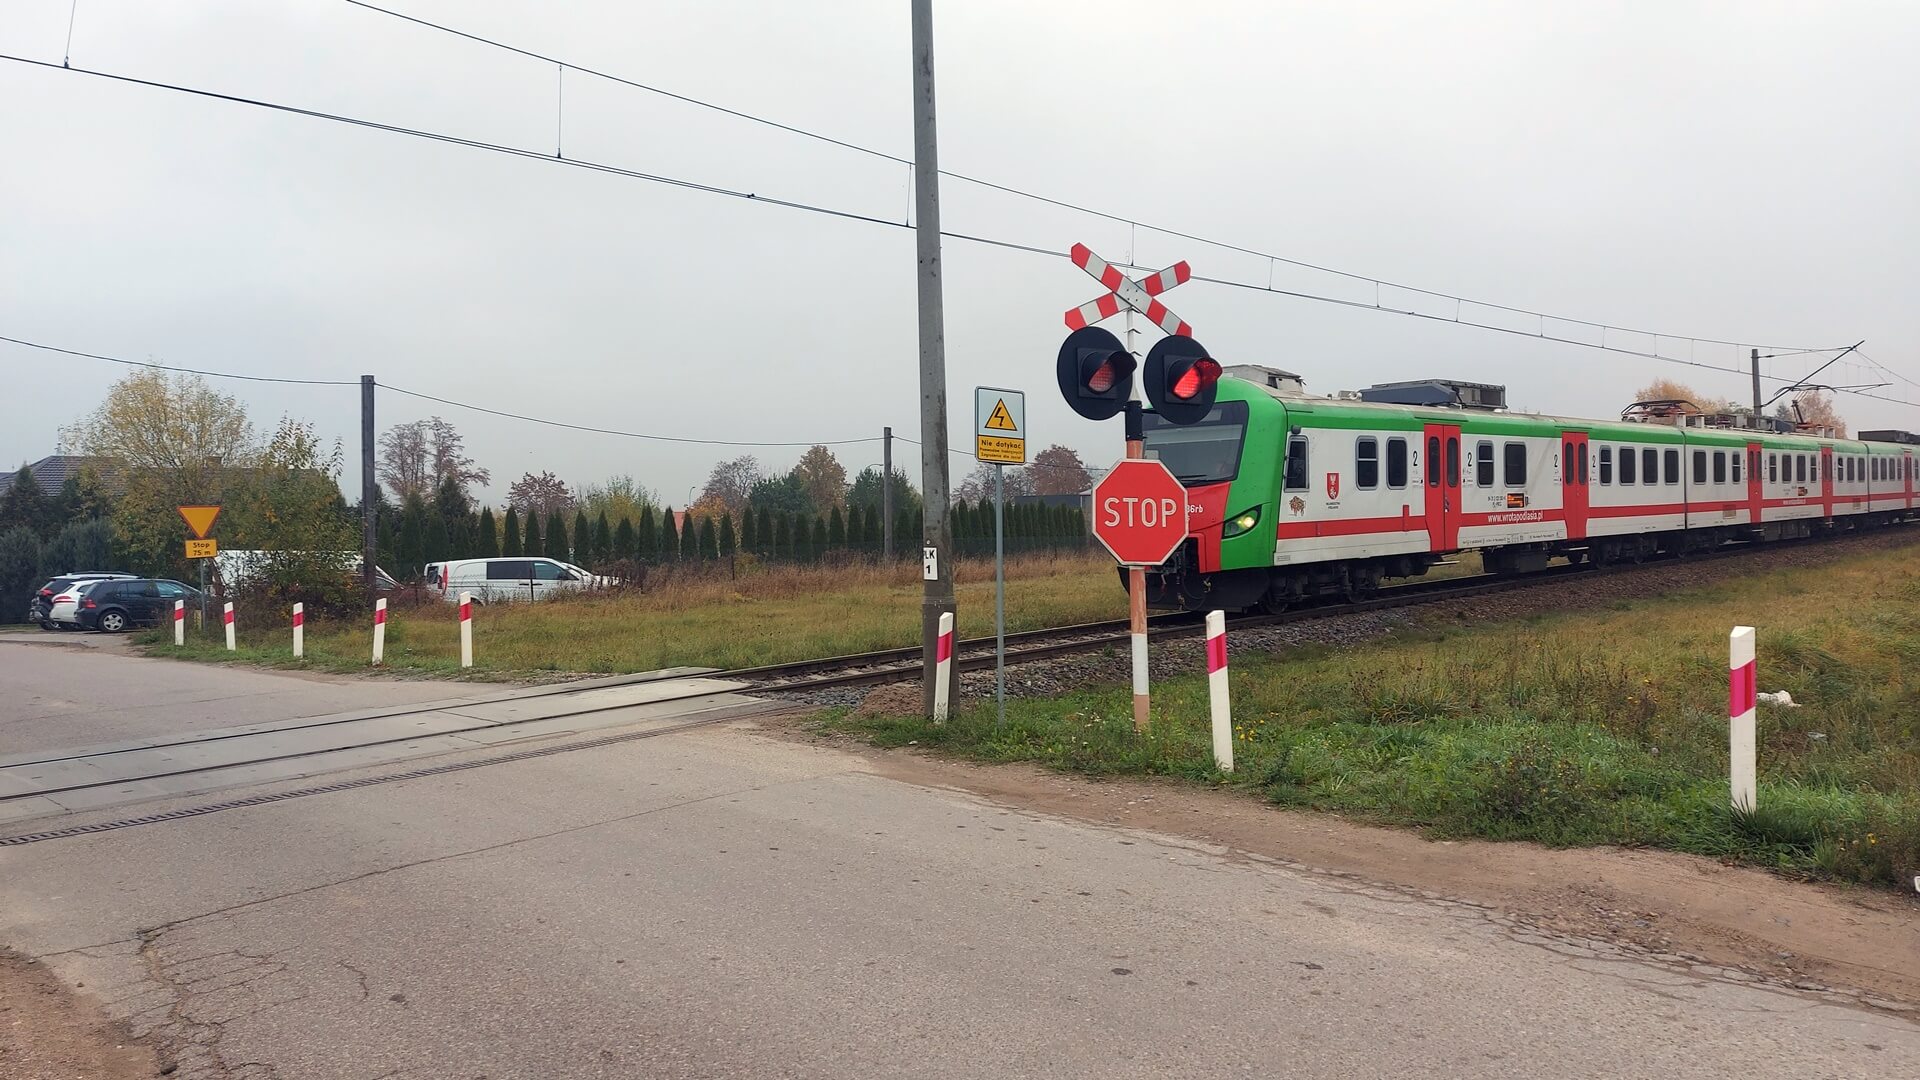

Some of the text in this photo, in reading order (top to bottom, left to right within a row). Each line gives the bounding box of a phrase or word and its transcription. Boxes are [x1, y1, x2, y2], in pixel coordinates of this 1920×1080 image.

[1412, 450, 1418, 466] 2
[1468, 452, 1472, 467] 2
[1554, 454, 1558, 468] 2
[1592, 454, 1596, 468] 2
[1104, 497, 1177, 528] STOP
[1488, 510, 1544, 524] www.wrotapodlasia.pl
[926, 564, 930, 574] 1
